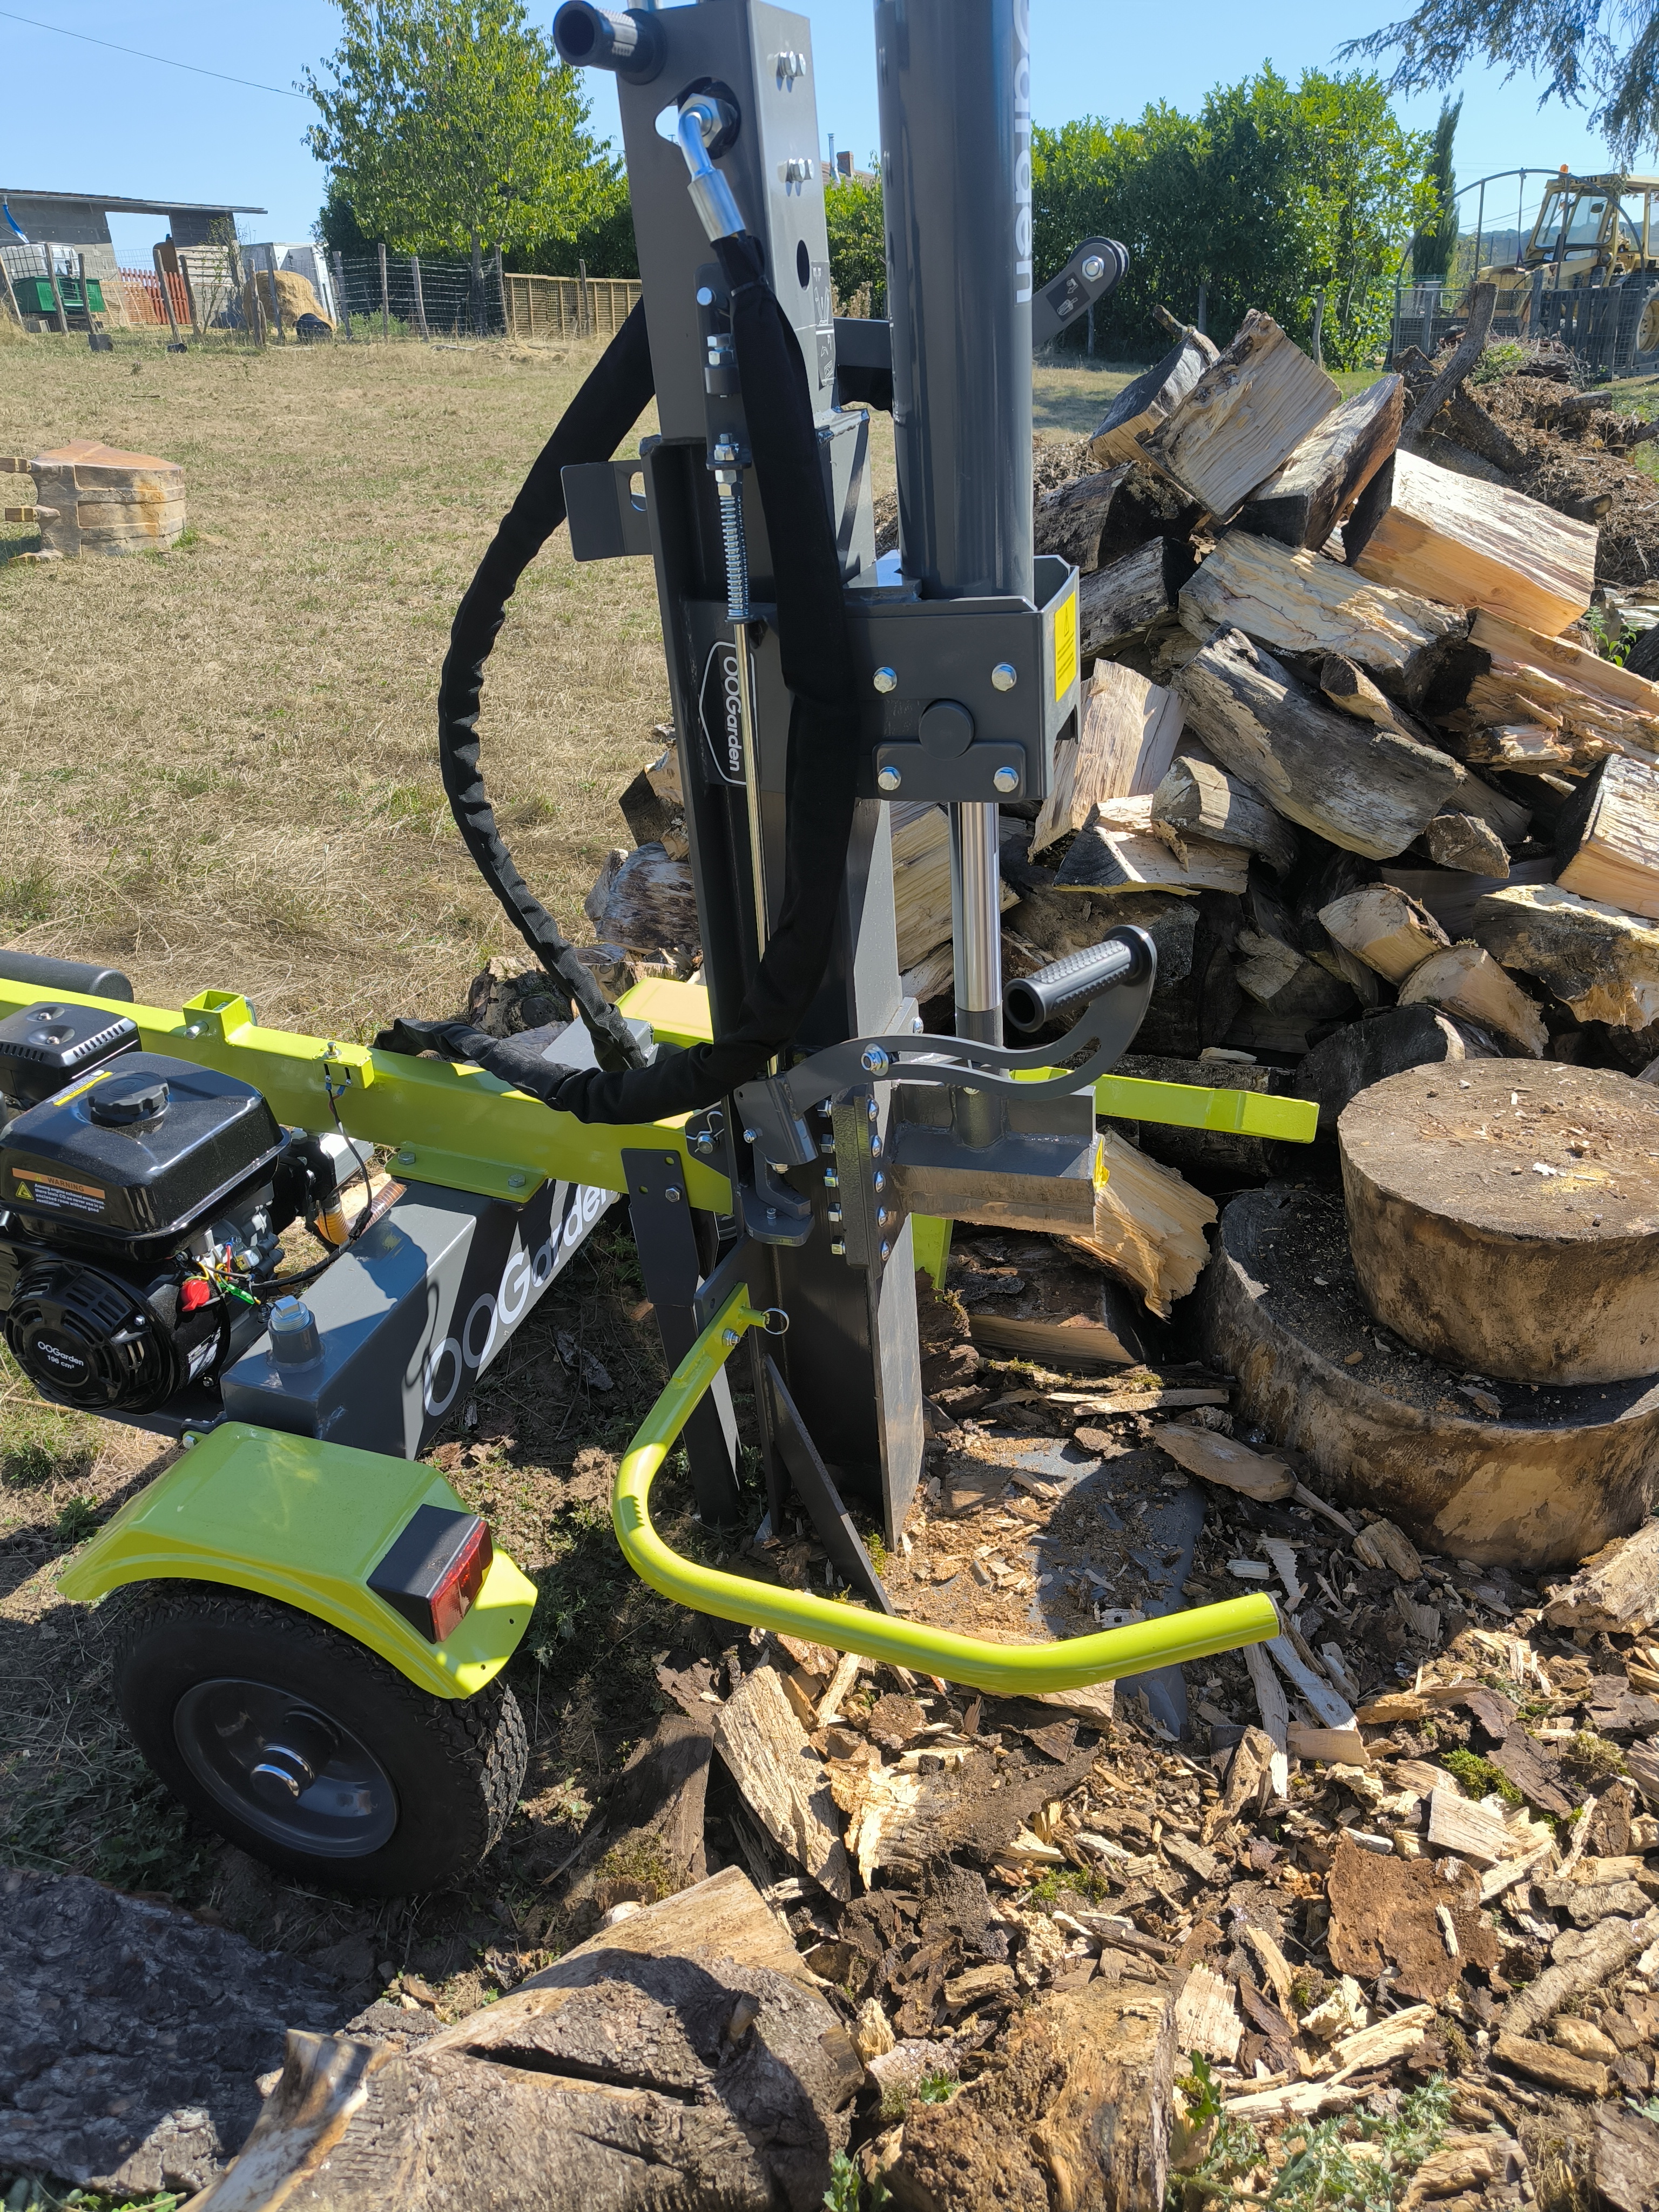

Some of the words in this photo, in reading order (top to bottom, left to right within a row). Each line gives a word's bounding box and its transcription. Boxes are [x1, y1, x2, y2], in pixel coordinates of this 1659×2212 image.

[723, 656, 742, 771] OOGarden
[47, 1177, 84, 1192] WARNING
[38, 1341, 84, 1366] OOGarden
